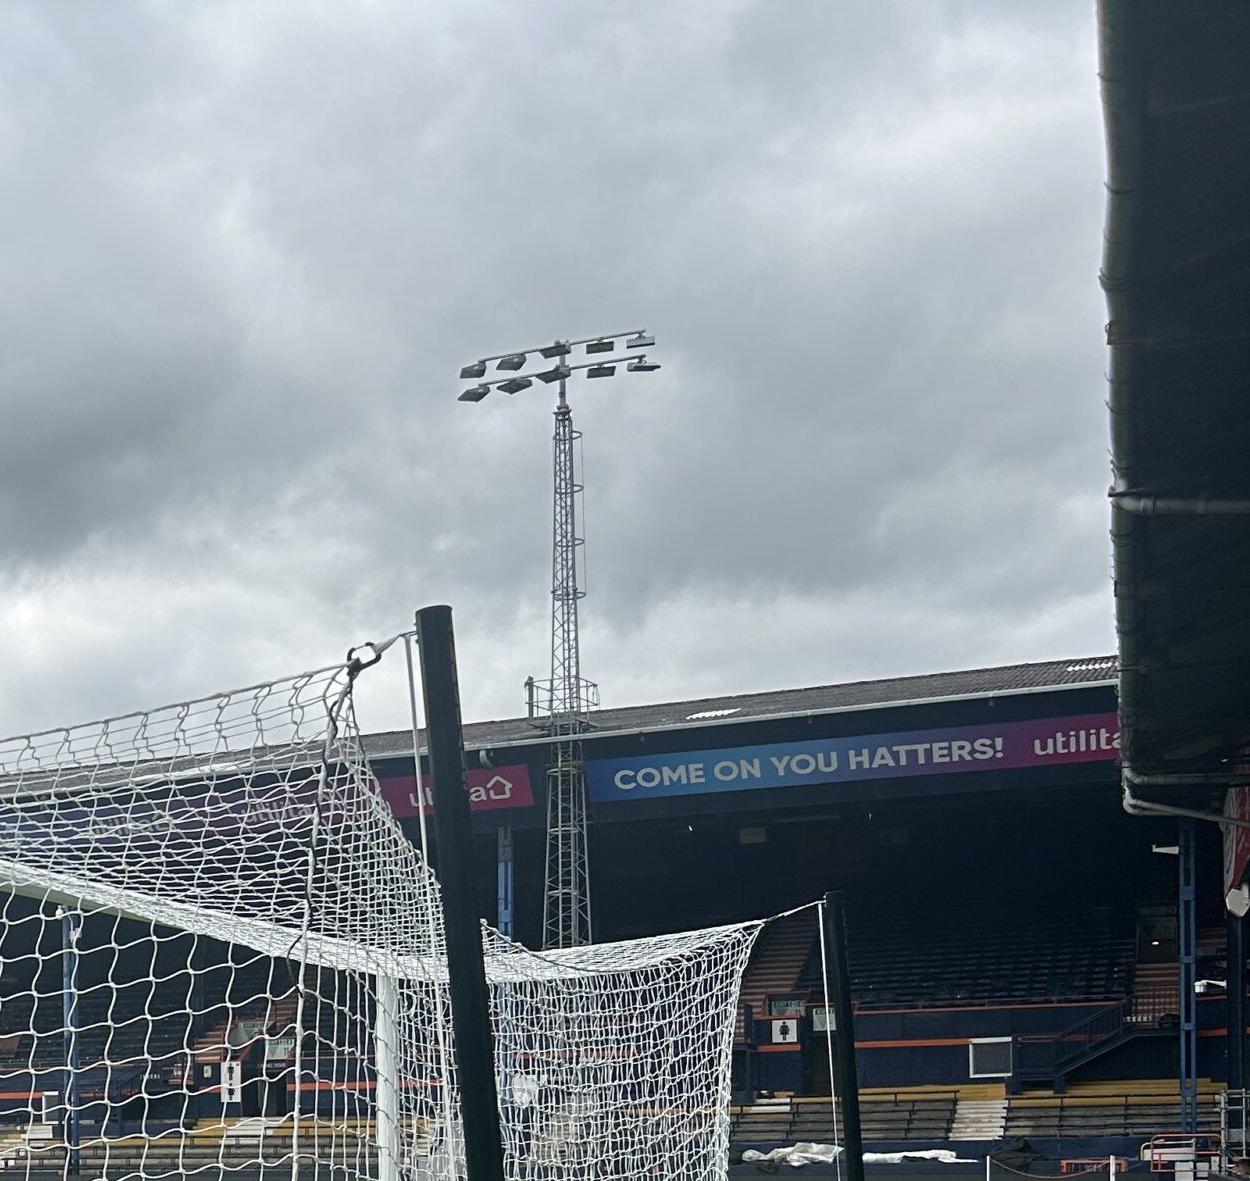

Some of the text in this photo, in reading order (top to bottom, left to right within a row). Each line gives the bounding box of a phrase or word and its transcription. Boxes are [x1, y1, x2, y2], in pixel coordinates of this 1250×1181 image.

[613, 736, 1004, 791] COME ON YOU HATTERS!
